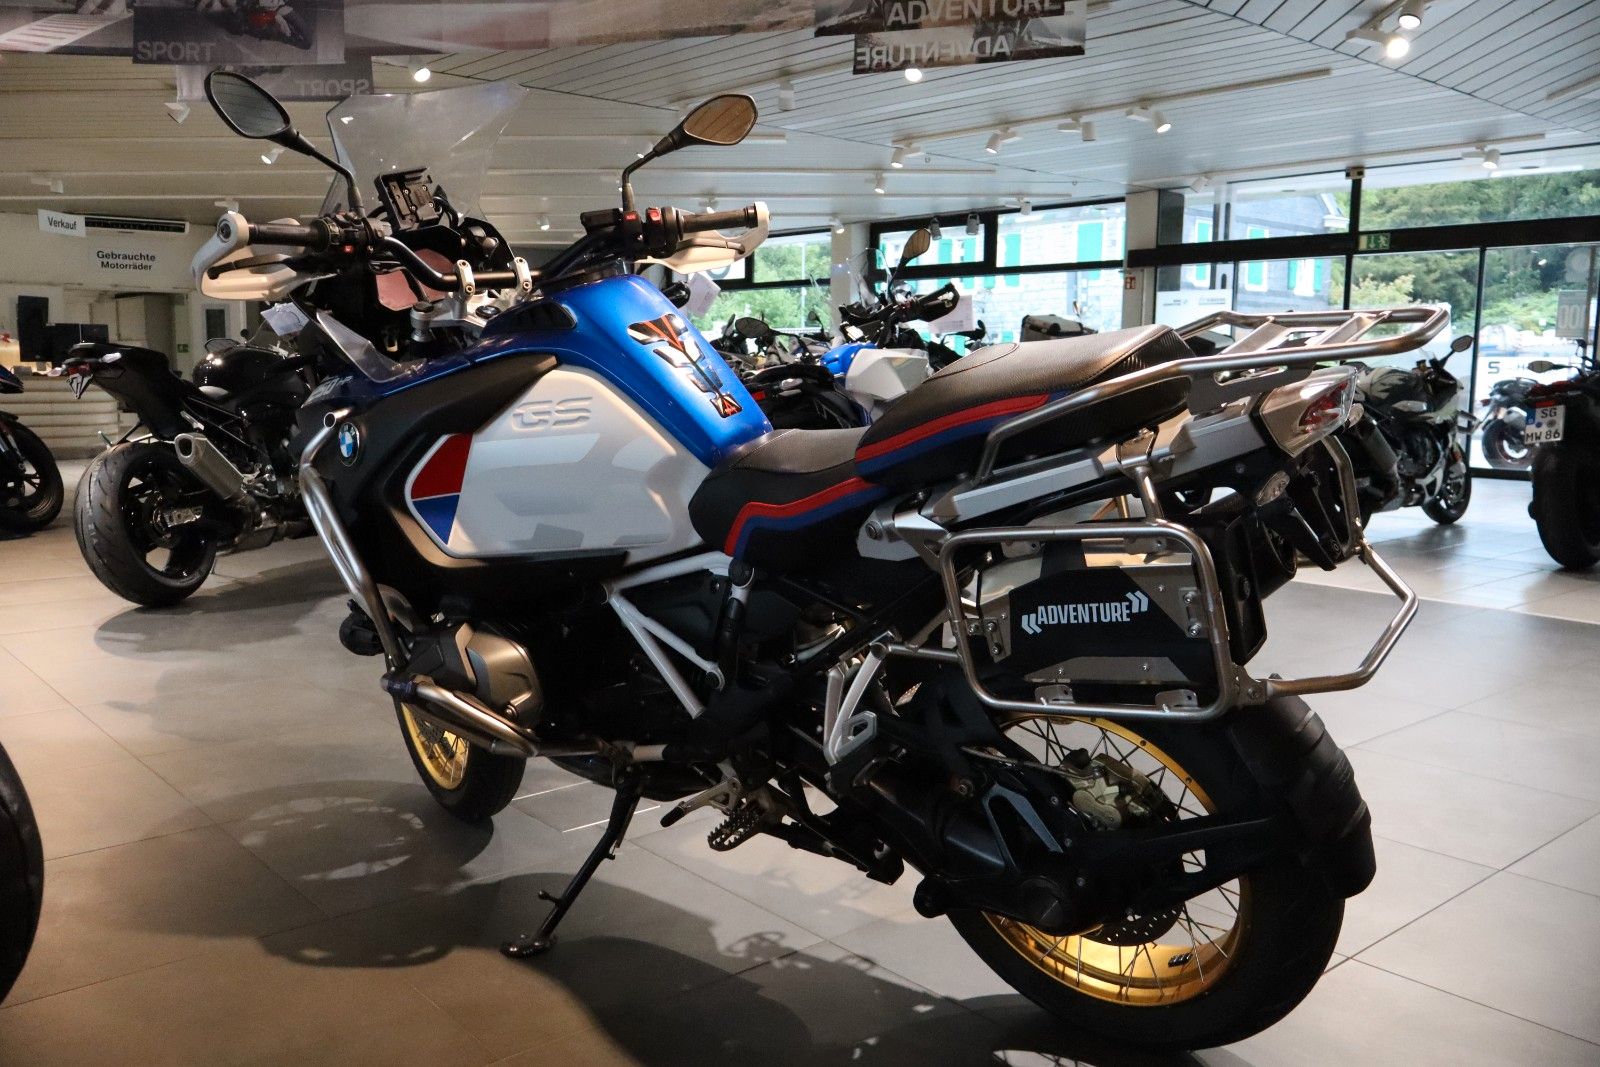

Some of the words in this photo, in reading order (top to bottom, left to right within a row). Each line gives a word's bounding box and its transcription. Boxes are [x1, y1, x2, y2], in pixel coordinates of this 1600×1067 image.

[136, 41, 217, 61] SPORT
[47, 216, 78, 231] Verkauf
[96, 250, 156, 262] Gebrauchte
[101, 261, 152, 271] Motorräder
[511, 396, 593, 432] GS
[1541, 407, 1557, 418] SG
[1037, 602, 1131, 625] ADVENTURE
